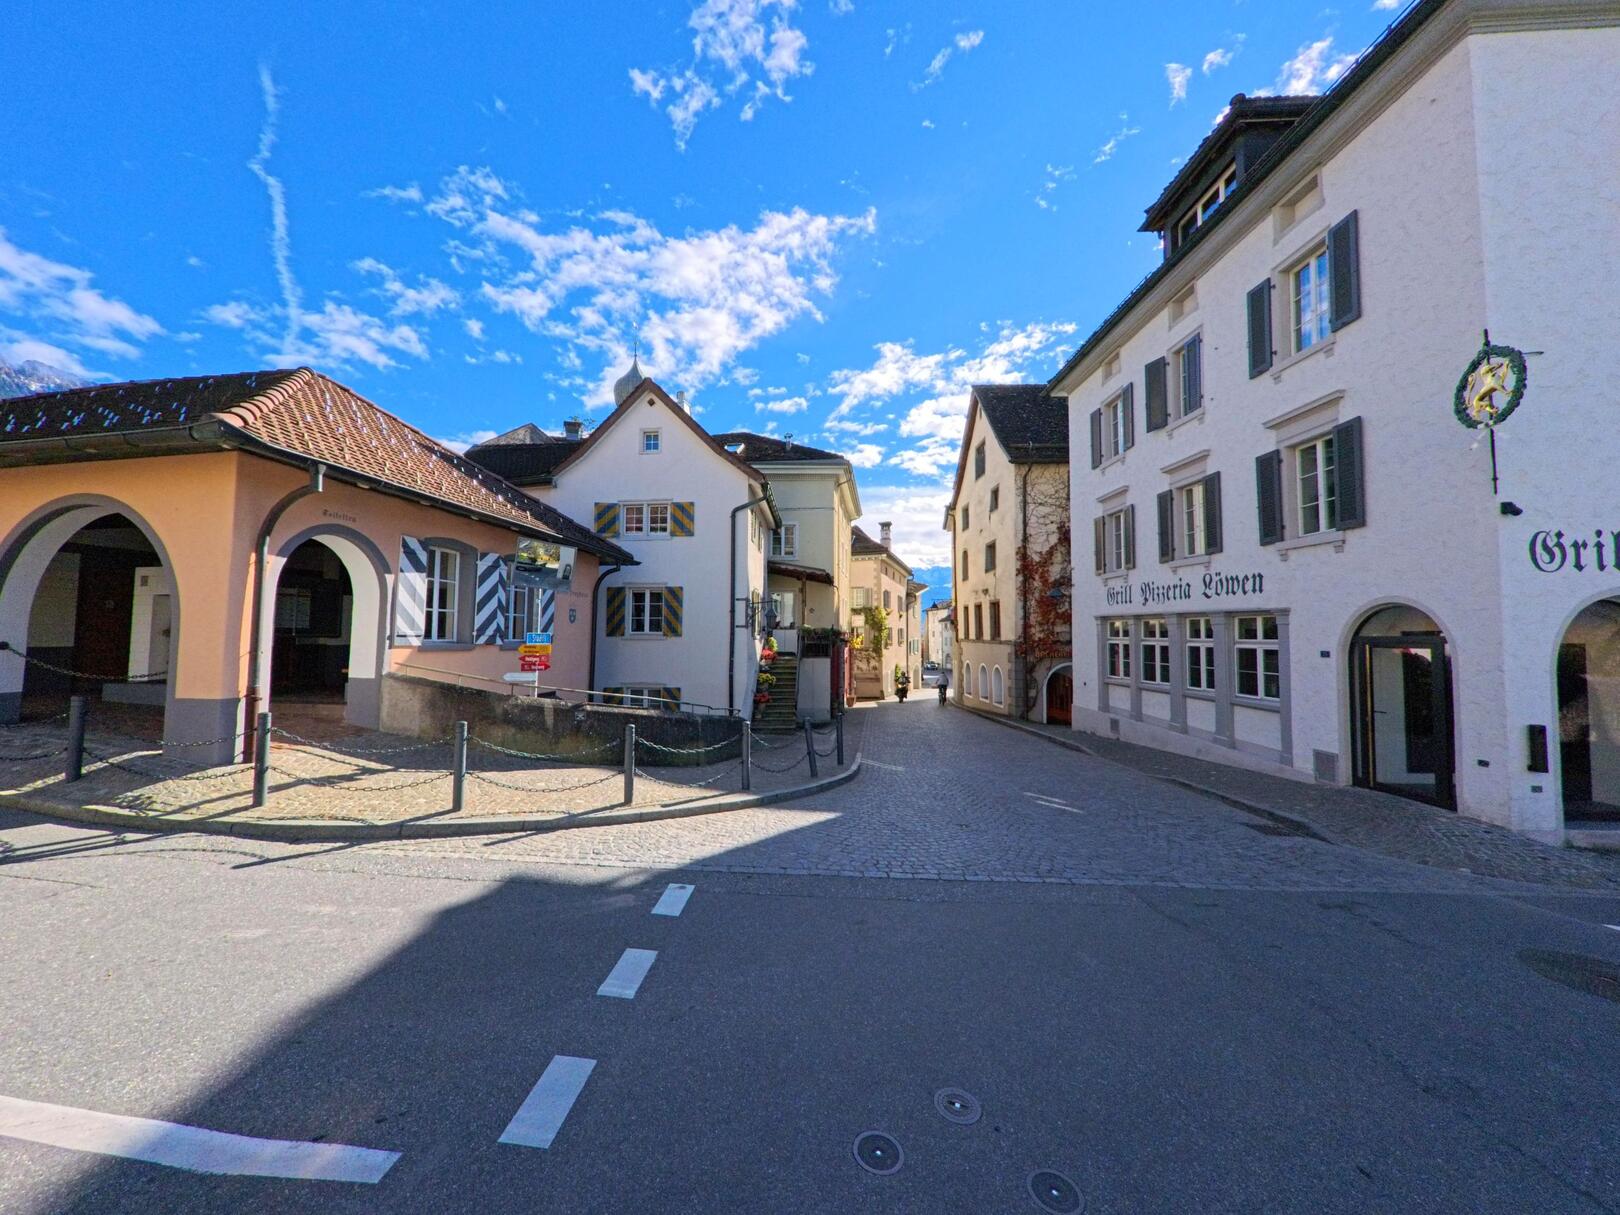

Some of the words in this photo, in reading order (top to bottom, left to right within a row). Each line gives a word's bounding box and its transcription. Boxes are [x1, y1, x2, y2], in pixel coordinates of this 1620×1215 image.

[1106, 583, 1133, 606] Grill
[1140, 577, 1192, 606] Pizzeria
[1202, 572, 1264, 599] Löwen
